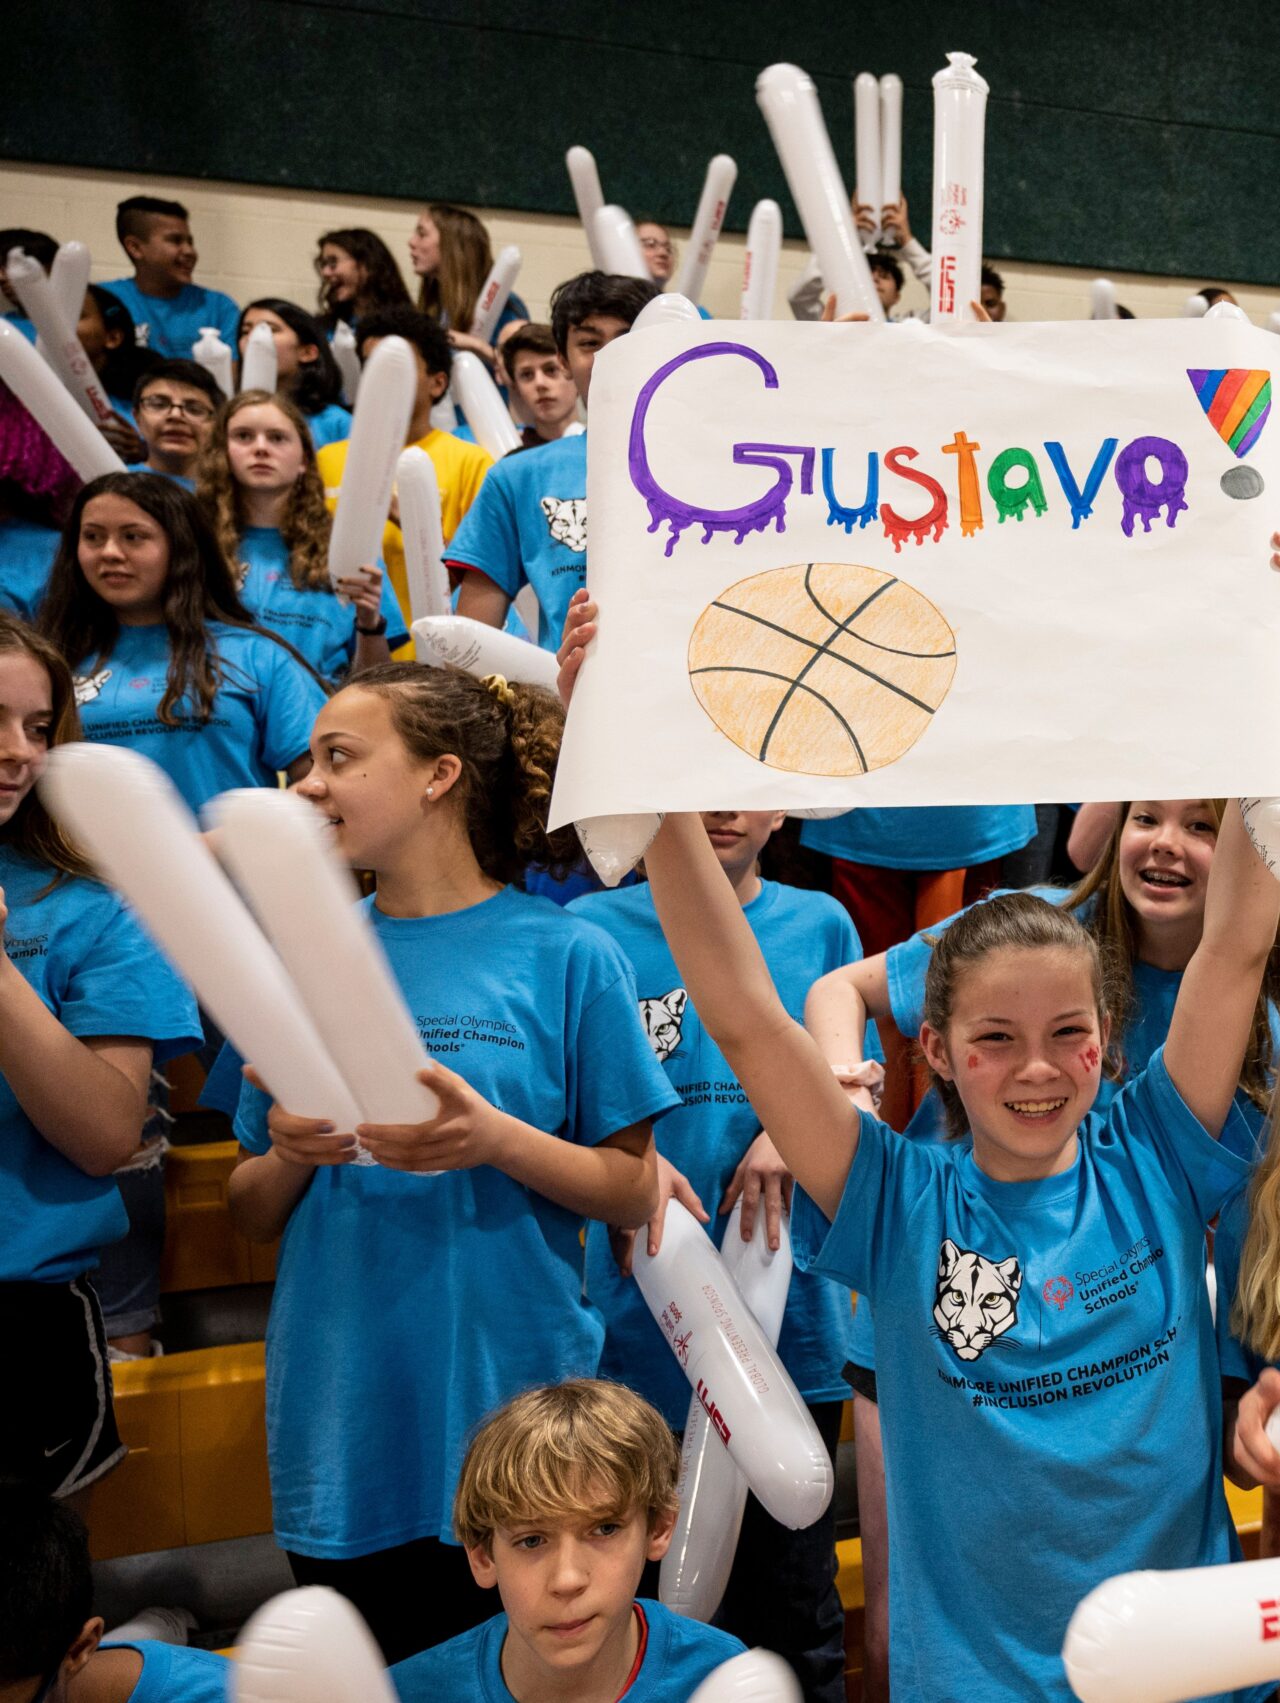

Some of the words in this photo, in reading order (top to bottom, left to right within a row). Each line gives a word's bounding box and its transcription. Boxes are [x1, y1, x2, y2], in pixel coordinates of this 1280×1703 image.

[938, 256, 956, 314] ESPN
[417, 1015, 458, 1027] Special
[460, 1015, 517, 1033] Olympics
[463, 1030, 525, 1050] Champion
[1074, 1260, 1119, 1287] Special
[1079, 1269, 1128, 1301] Unified
[701, 1284, 728, 1320] SPONSOR
[720, 1318, 750, 1366] PRESENTING
[747, 1367, 770, 1394] GLOBAL
[972, 1389, 1068, 1409] #INCLUSION
[1072, 1350, 1170, 1397] REVOLUTION
[1000, 1371, 1063, 1394] UNIFIED
[1067, 1343, 1152, 1381] CHAMPION
